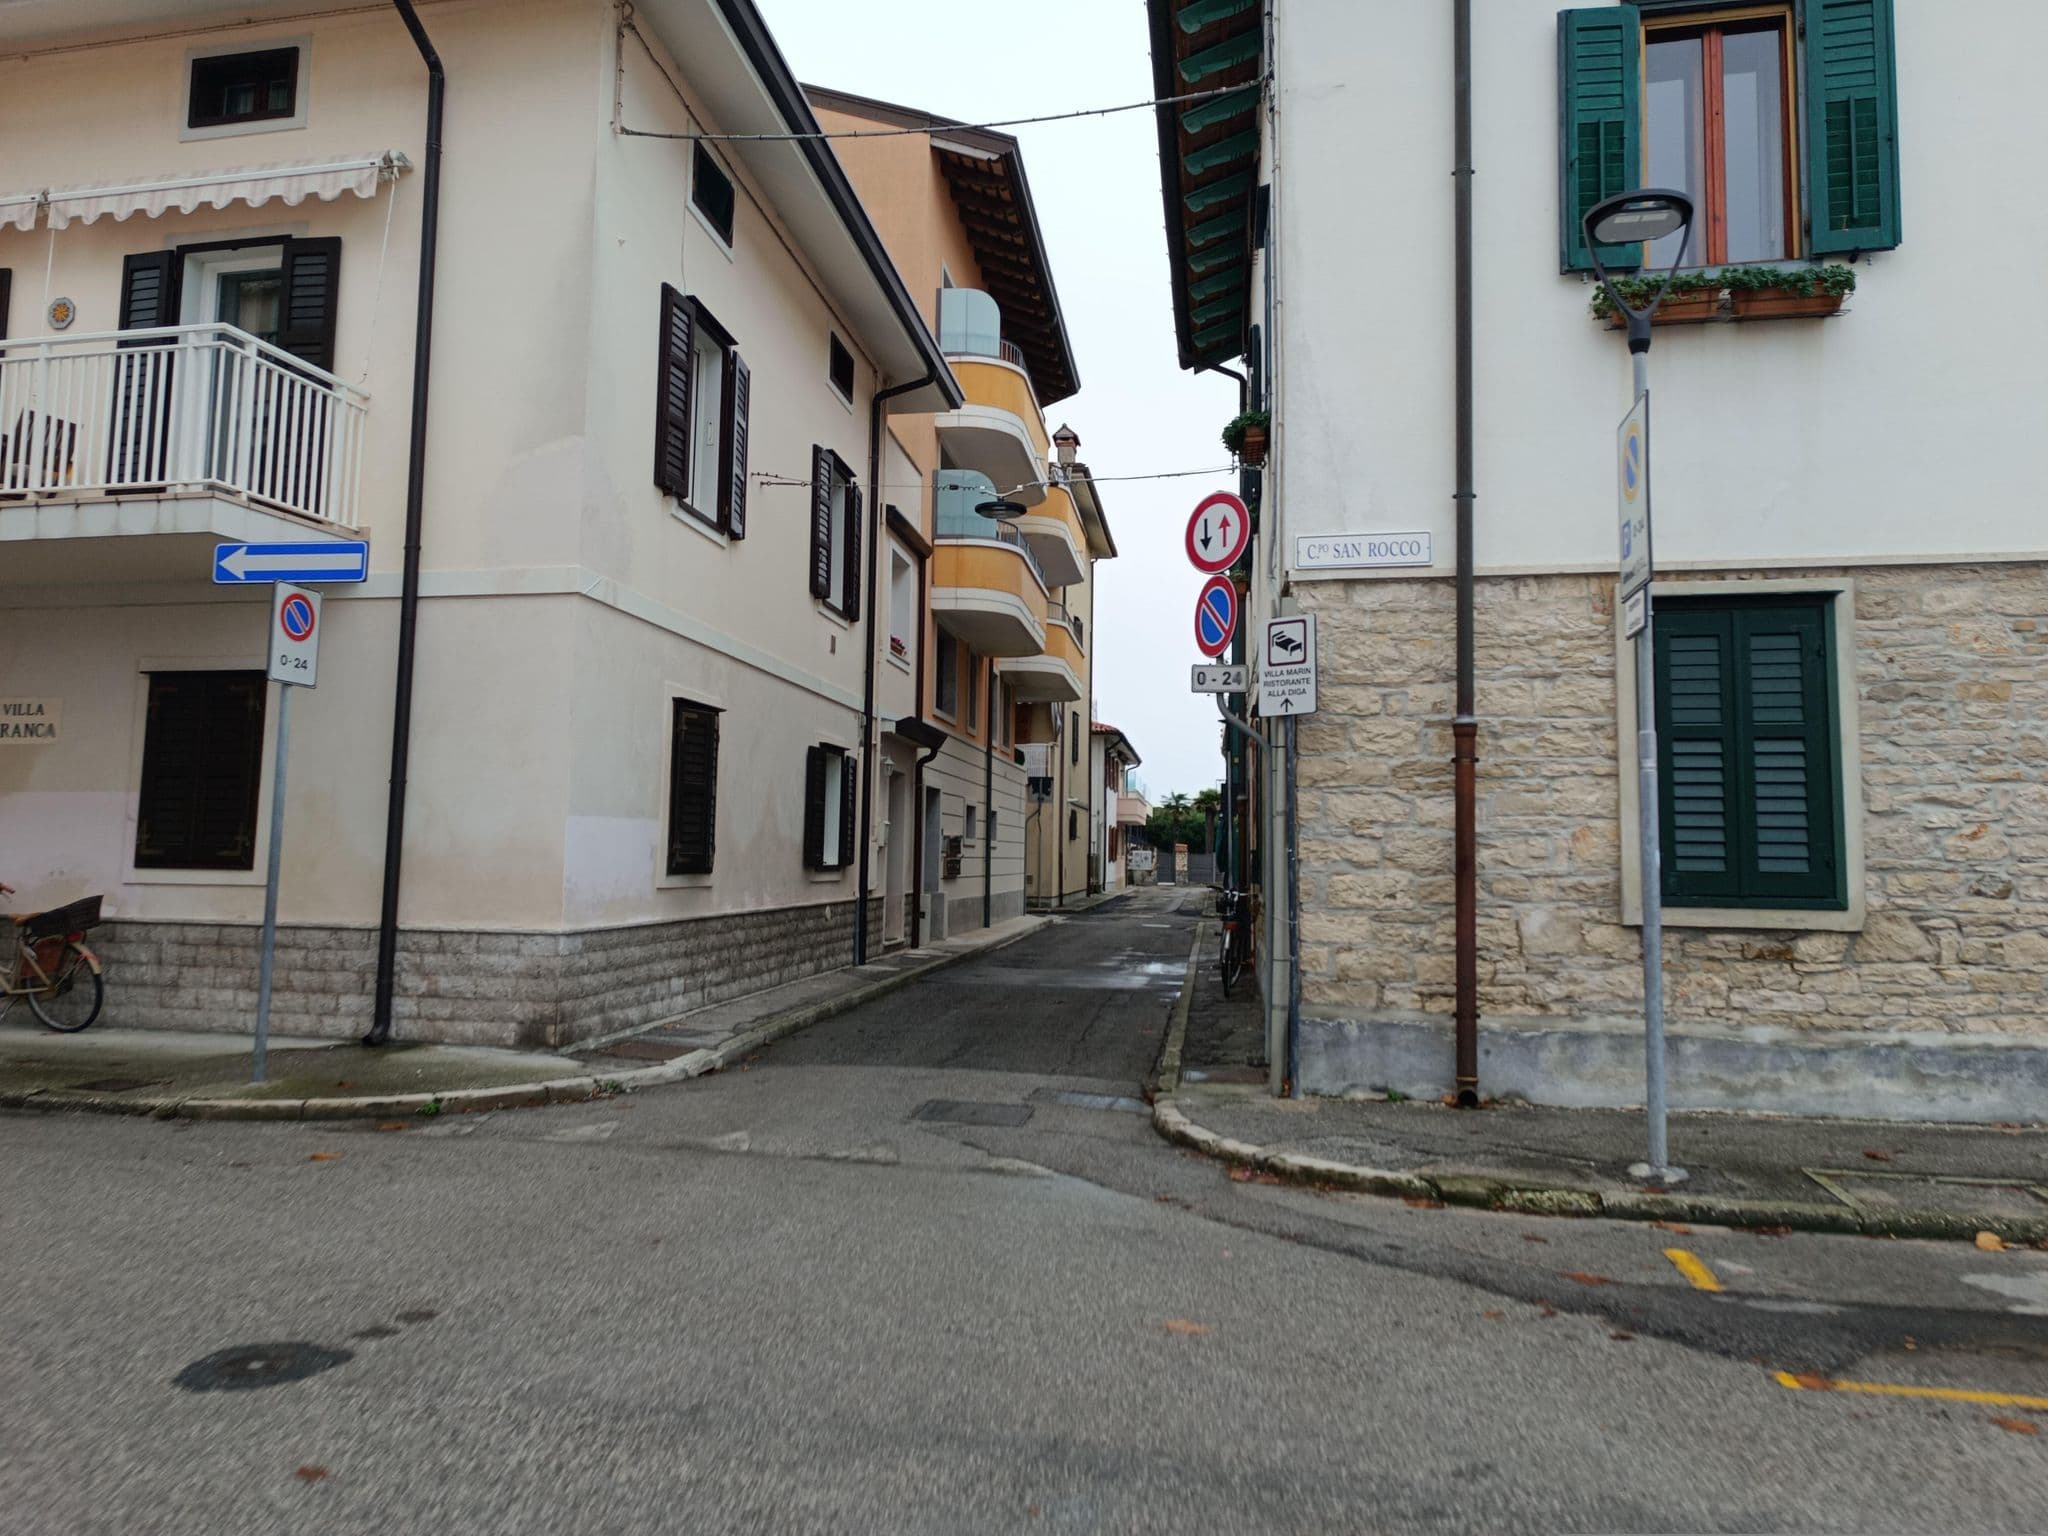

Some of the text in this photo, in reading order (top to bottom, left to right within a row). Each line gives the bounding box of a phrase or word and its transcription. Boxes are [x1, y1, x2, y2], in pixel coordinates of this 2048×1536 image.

[1333, 542, 1362, 559] SAN
[1368, 540, 1421, 557] ROCCO
[280, 654, 308, 670] 0-24
[1263, 667, 1311, 678] VILLA MARIN
[1263, 677, 1311, 688] RISTORANTE
[1268, 689, 1286, 697] ALLA
[3, 703, 45, 716] VILLA
